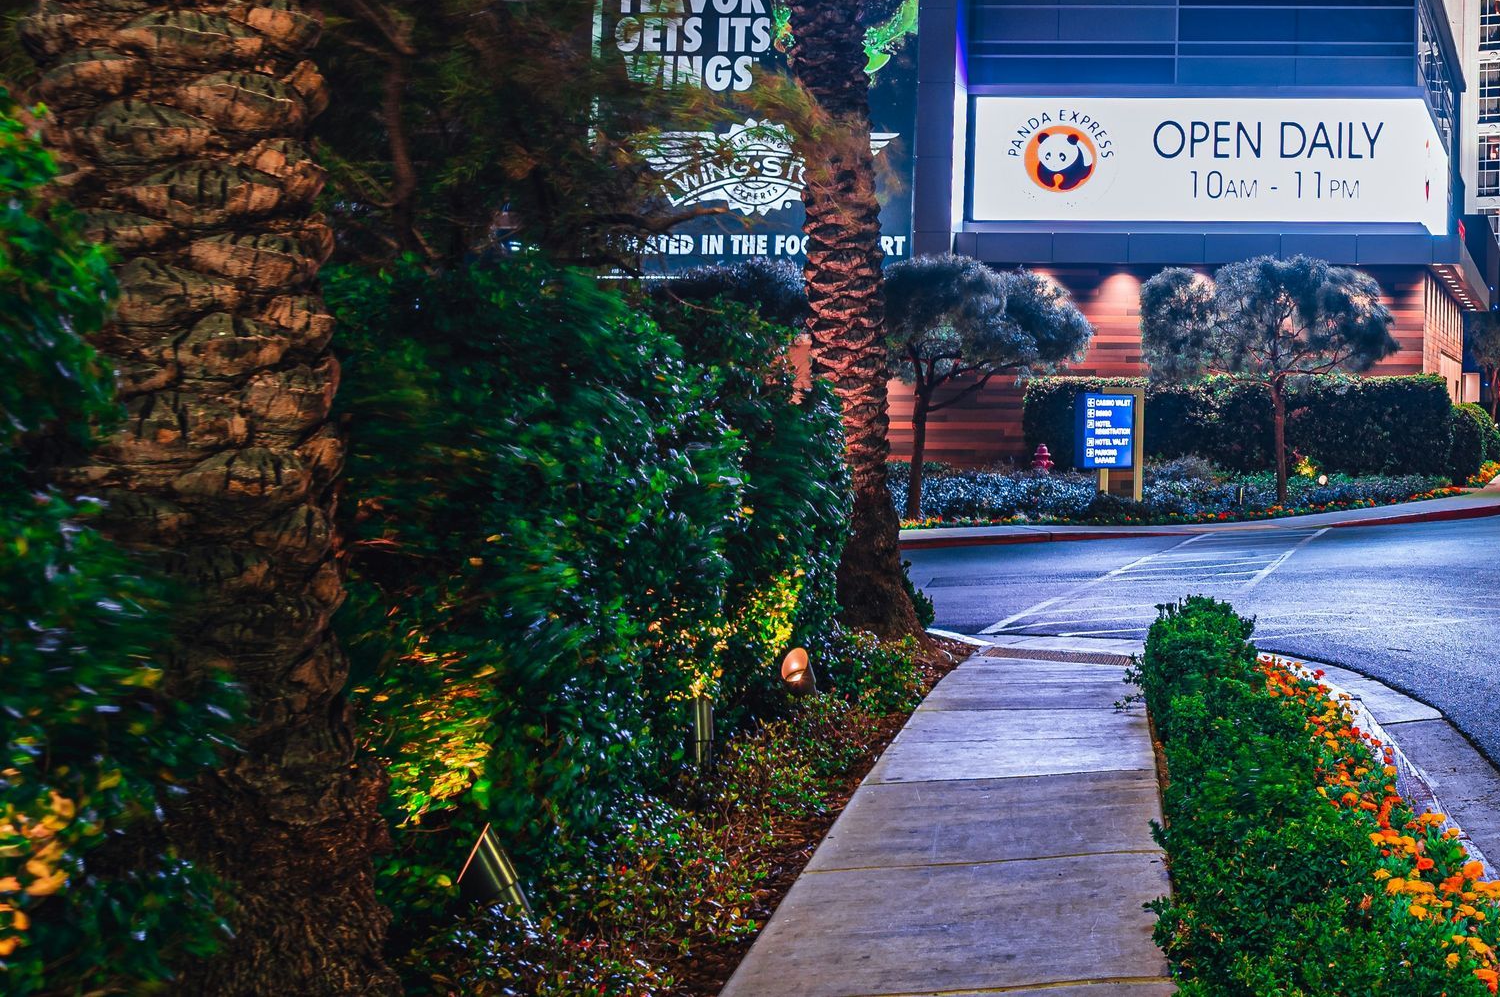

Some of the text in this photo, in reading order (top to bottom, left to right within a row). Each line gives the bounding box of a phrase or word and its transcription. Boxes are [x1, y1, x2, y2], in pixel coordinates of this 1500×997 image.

[614, 16, 771, 52] GETS ITS
[624, 55, 753, 91] WINGS
[1008, 109, 1115, 158] PANDA EXPRESS
[1153, 120, 1385, 159] OPEN DAILY
[1190, 170, 1258, 199] 10AM
[1294, 171, 1360, 199] 11PM
[701, 235, 724, 255] IN
[730, 234, 767, 255] THE
